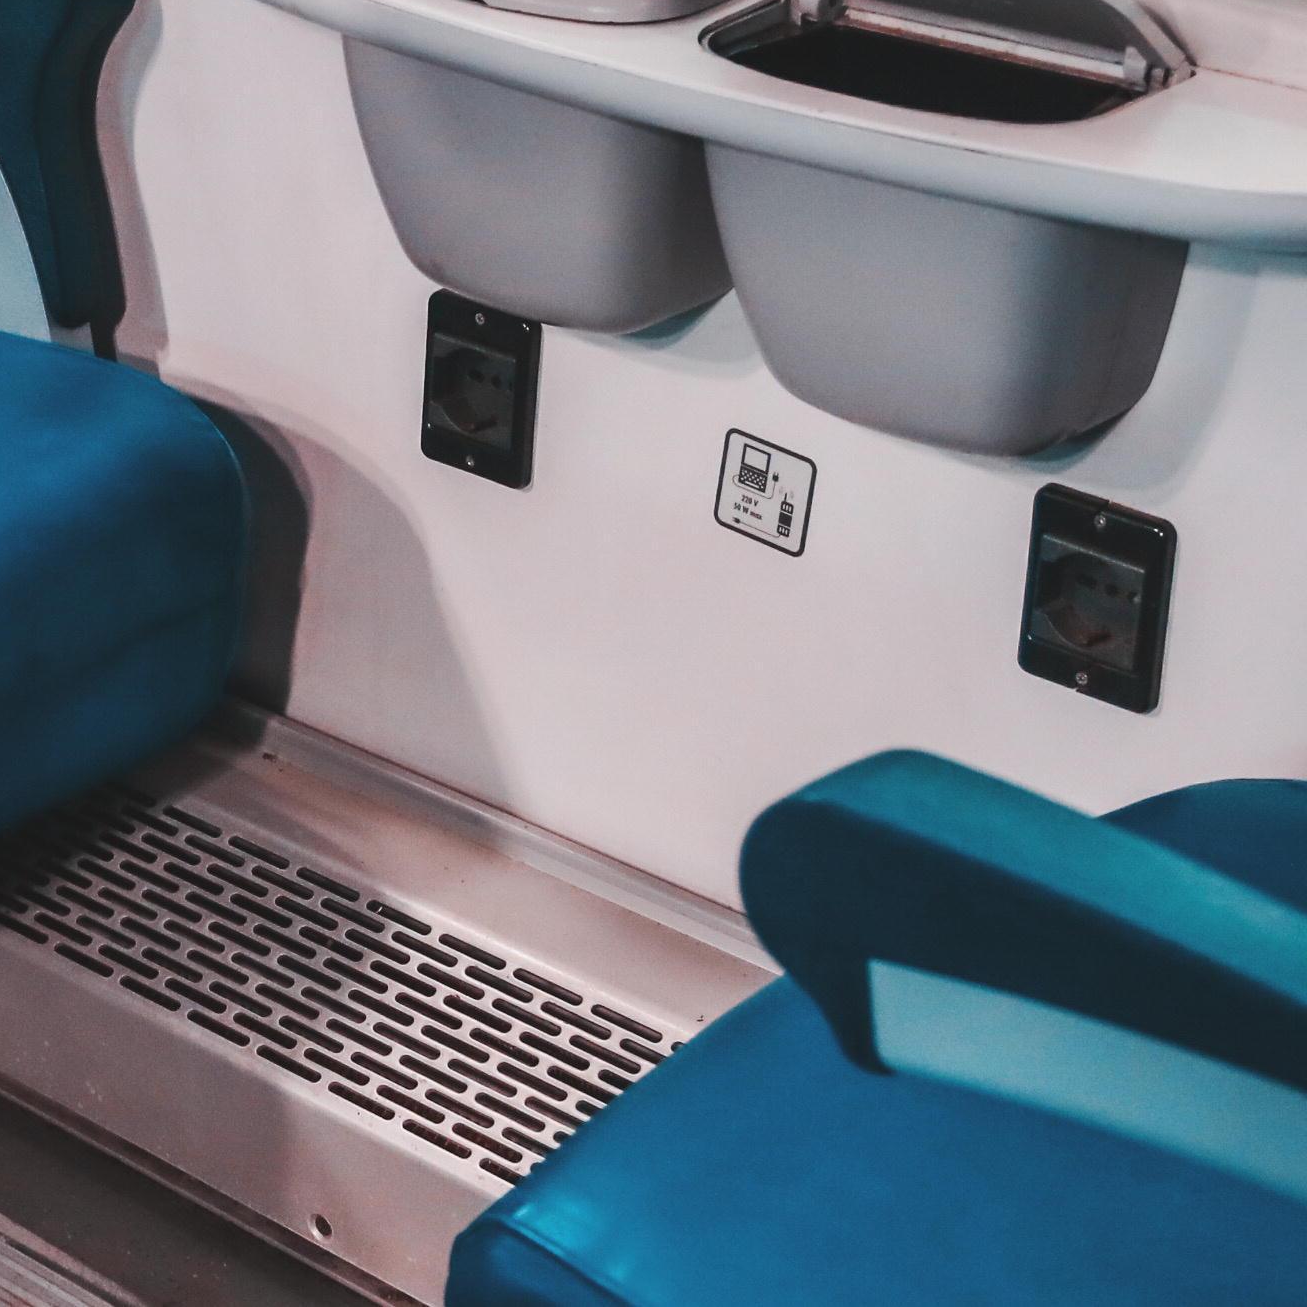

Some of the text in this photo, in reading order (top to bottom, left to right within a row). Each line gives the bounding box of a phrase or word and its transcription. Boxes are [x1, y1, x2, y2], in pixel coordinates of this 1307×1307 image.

[741, 495, 759, 507] 220 V
[742, 505, 749, 514] W
